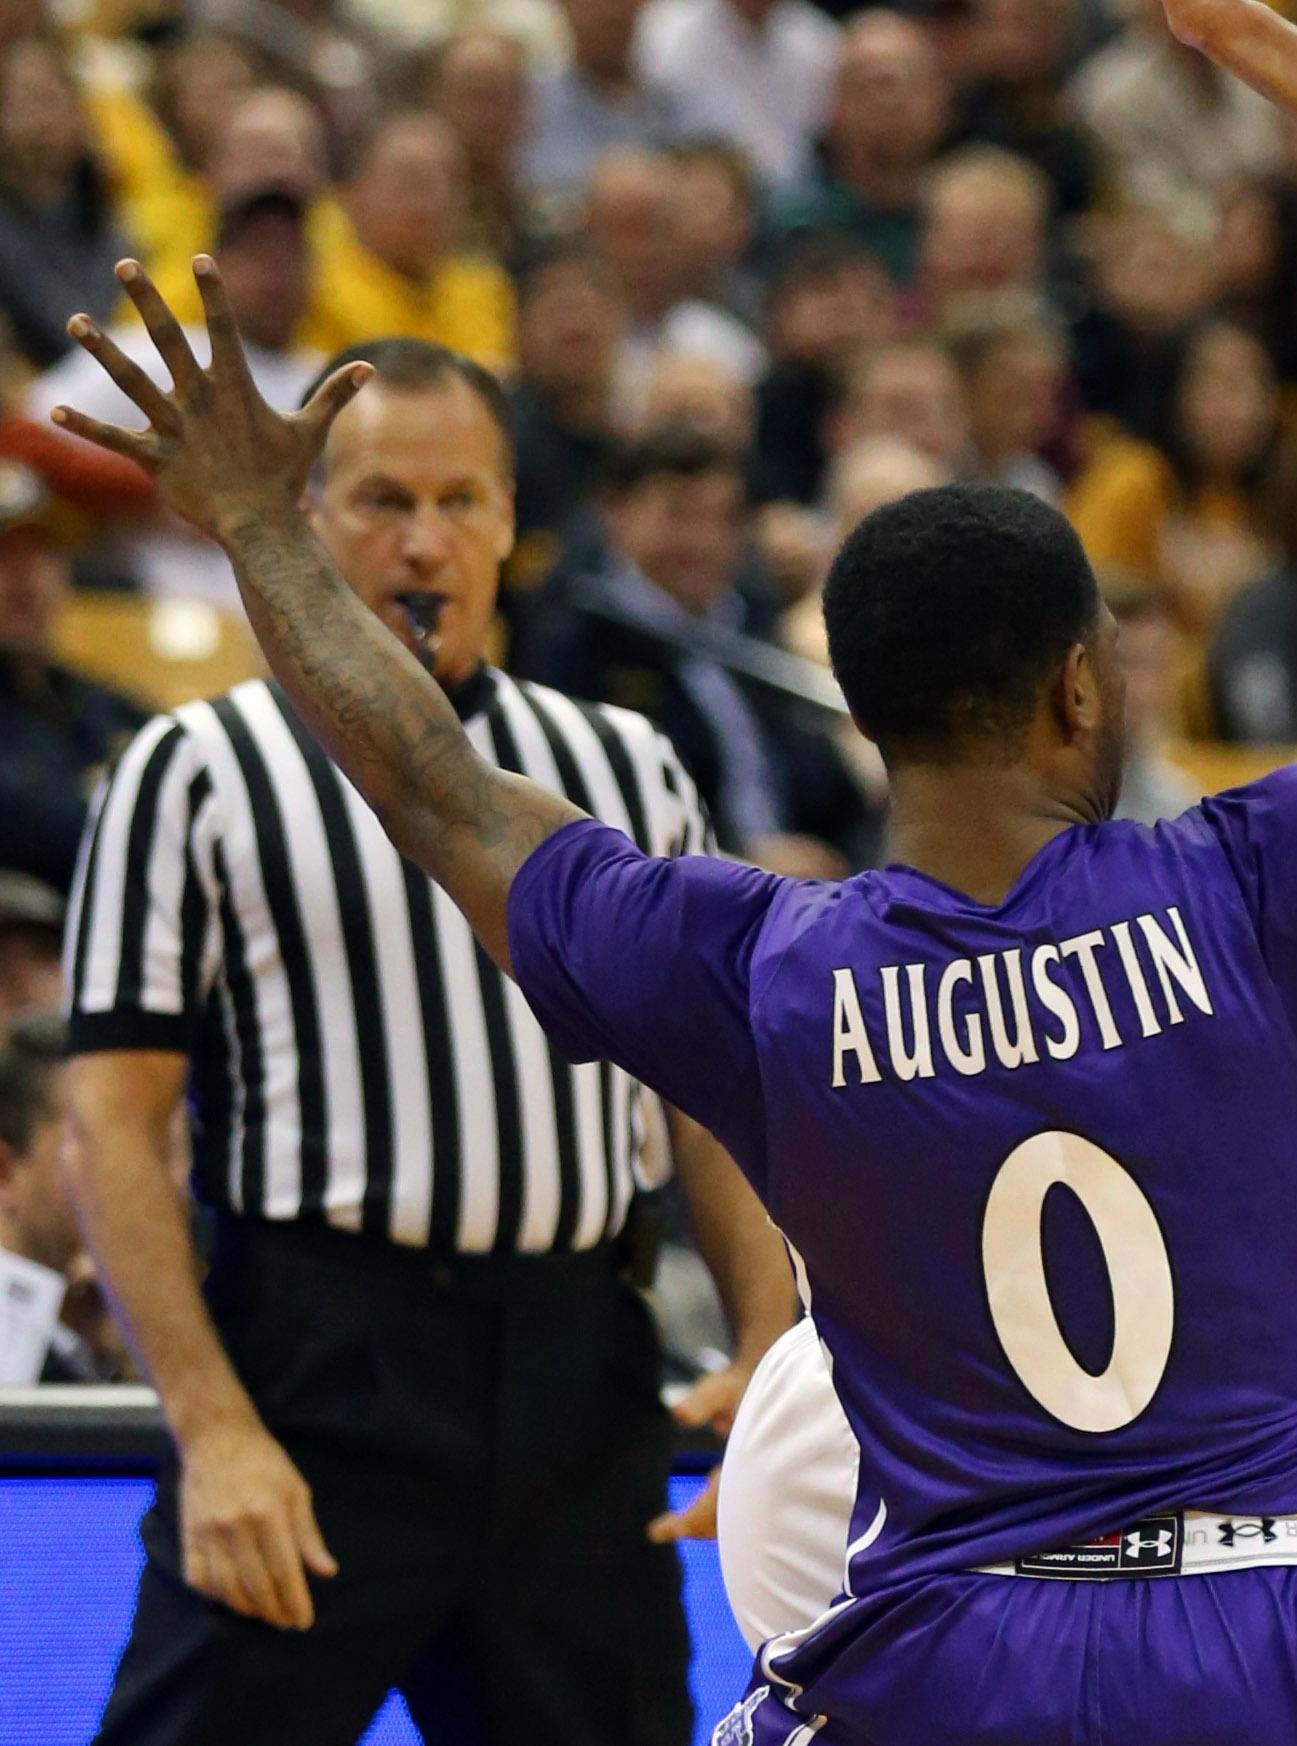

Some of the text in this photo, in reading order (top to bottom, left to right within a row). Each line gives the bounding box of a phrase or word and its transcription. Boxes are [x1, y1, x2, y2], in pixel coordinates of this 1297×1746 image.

[831, 906, 1214, 1088] AUGUSTIN
[982, 1130, 1174, 1433] 0
[1077, 1554, 1116, 1562] UNDER
